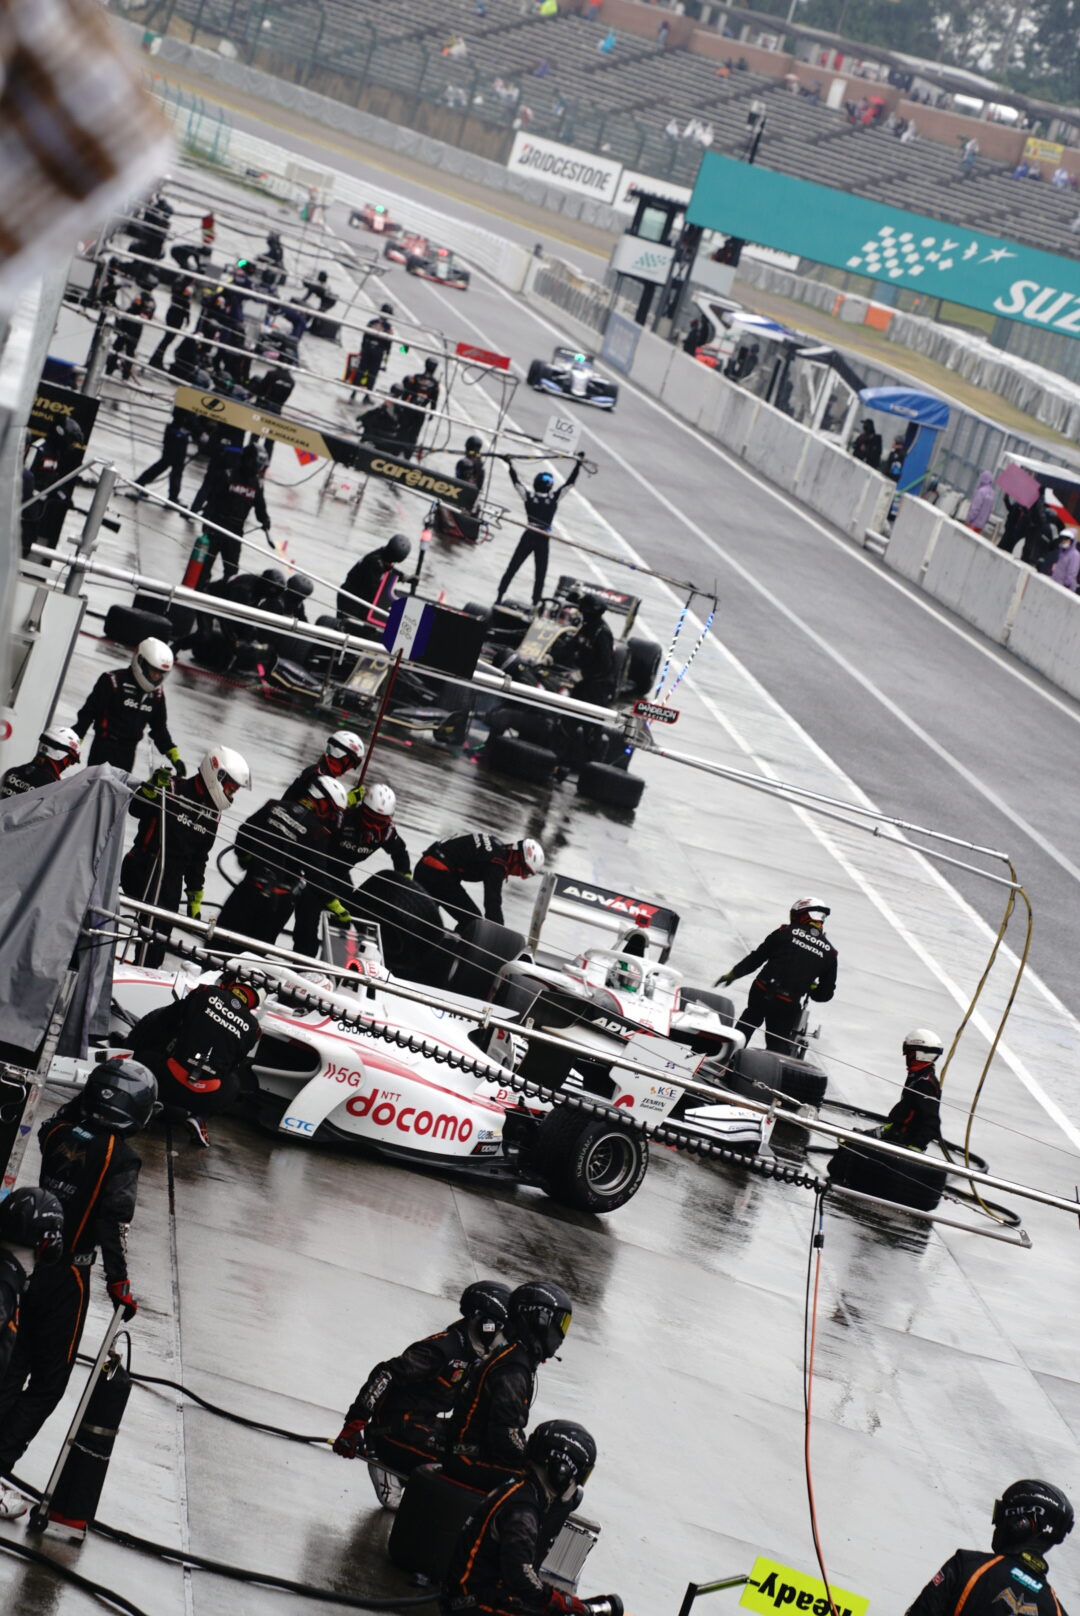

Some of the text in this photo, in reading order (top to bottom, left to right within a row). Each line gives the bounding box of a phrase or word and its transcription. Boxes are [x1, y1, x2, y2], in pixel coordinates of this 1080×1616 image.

[518, 144, 613, 191] BRIDGESTONE
[993, 279, 1080, 332] SUZ
[638, 702, 677, 720] DANDELION
[563, 885, 650, 917] ADVAN
[791, 928, 831, 951] docomo
[791, 937, 824, 959] HONDA
[205, 1007, 241, 1040] HONDA
[208, 996, 250, 1032] docomo
[592, 1016, 637, 1040] ADV
[380, 1090, 402, 1102] NTT
[657, 1086, 677, 1098] KSE
[284, 1116, 316, 1133] CTC
[345, 1088, 474, 1143] docomo
